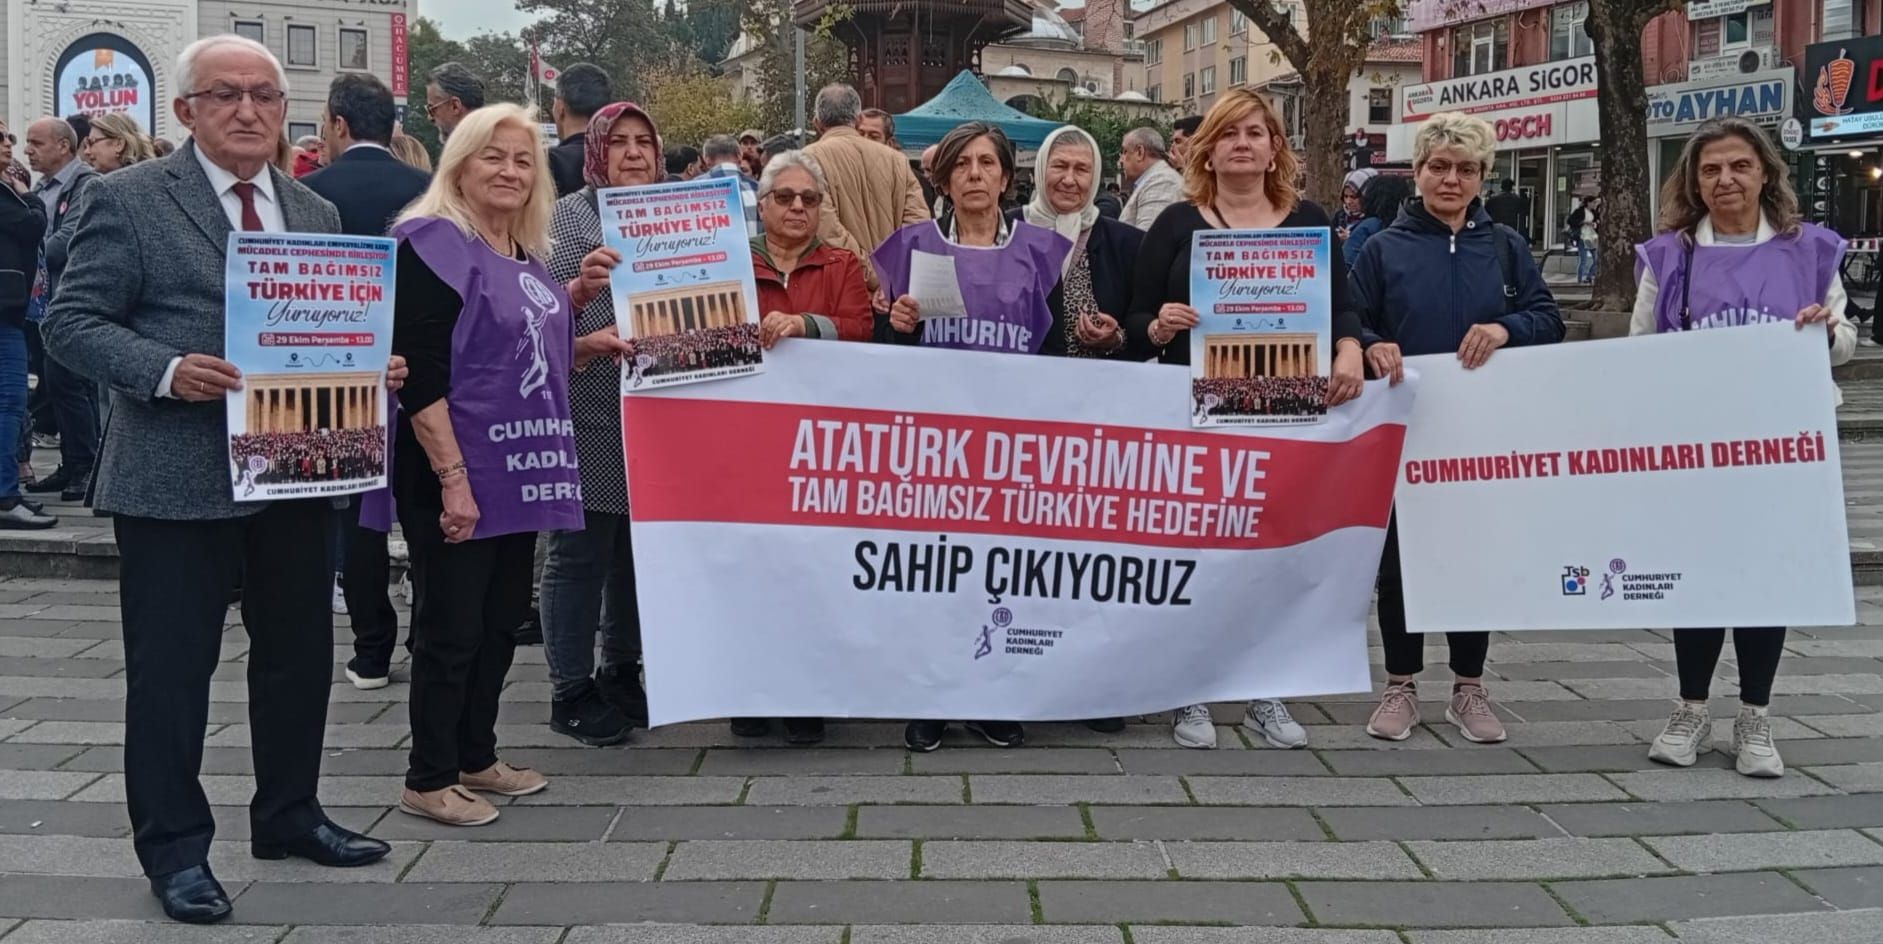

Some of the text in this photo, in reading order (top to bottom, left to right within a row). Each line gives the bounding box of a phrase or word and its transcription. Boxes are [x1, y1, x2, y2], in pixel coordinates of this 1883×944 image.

[1439, 62, 1598, 106] ANKARA SİGOR
[73, 88, 138, 109] YOLUN
[1675, 82, 1782, 122] AYHAN
[1494, 113, 1552, 142] OSCH
[616, 200, 727, 220] TAM BAĞIMSIZ
[618, 213, 731, 239] TÜRKİYE İÇİN
[237, 245, 287, 256] MÜCADELE
[289, 248, 345, 258] CEPHESİNDE
[1206, 248, 1313, 261] TAM BAĞIMSIZ
[248, 260, 382, 277] TAM BAĞIMSIZ
[1205, 262, 1315, 282] TÜRKİYE İÇİN
[247, 277, 382, 306] TÜRKİYE İÇİN
[276, 336, 287, 344] 29
[288, 336, 310, 344] Ekim
[790, 415, 1271, 500] ATATÜRK DEVRİMİNE VE
[1405, 430, 1826, 485] CUMHURİYET KADINLARI DERNEĞİ
[266, 486, 318, 496] CUMHURİYET
[320, 483, 357, 493] KADINLARI
[788, 473, 1264, 538] TAM BAĞIMSIZ TÜRKİYE HEDEFİNE
[853, 534, 1197, 605] SAHİP ÇIKIYORUZ
[1621, 573, 1682, 582] CUMHURİYET
[1622, 583, 1674, 591] KADINLARI
[1623, 592, 1664, 600] DERNEĞİ
[1006, 637, 1054, 647] KADINLARI
[1007, 628, 1063, 638] CUMHURİYET
[1005, 646, 1044, 656] DERNEĞİ
